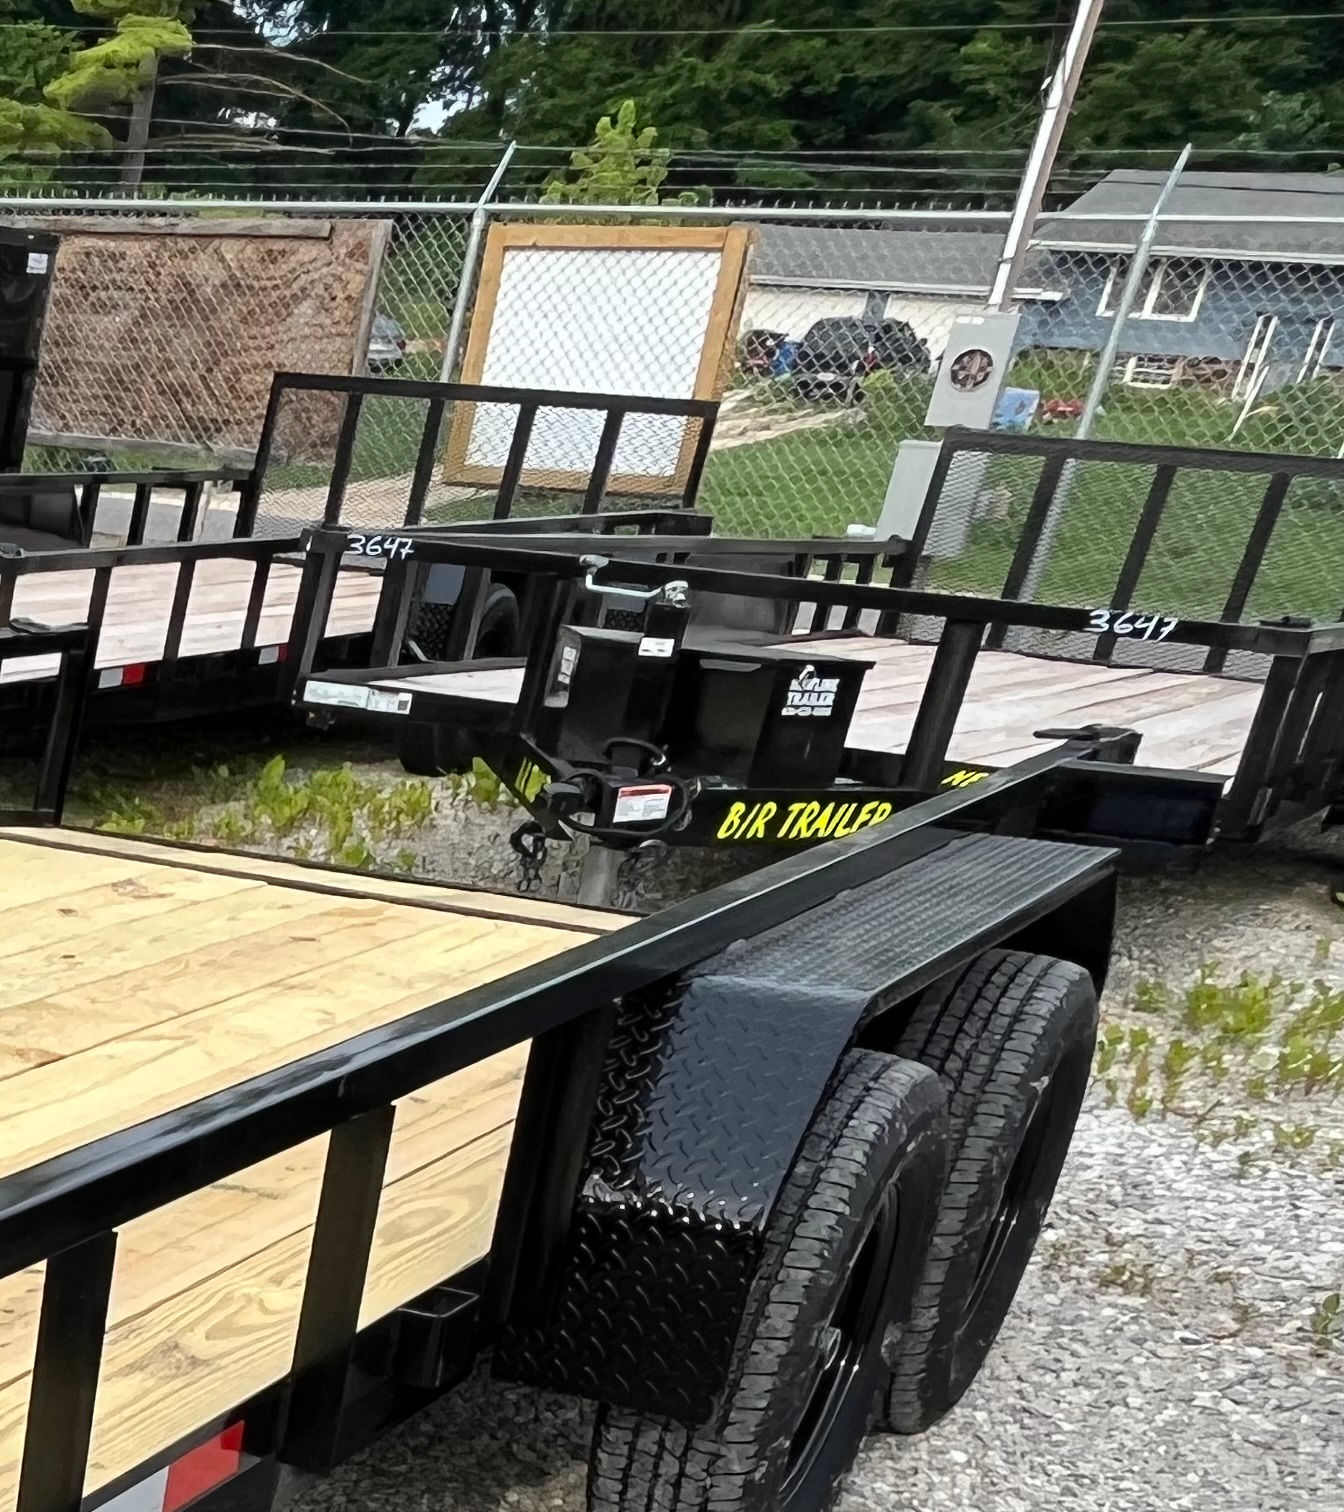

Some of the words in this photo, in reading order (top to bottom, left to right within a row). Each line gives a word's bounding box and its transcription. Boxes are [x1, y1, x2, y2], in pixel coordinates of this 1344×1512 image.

[345, 533, 414, 560] 3647
[1083, 608, 1179, 642] 3647
[717, 801, 777, 839] B/R
